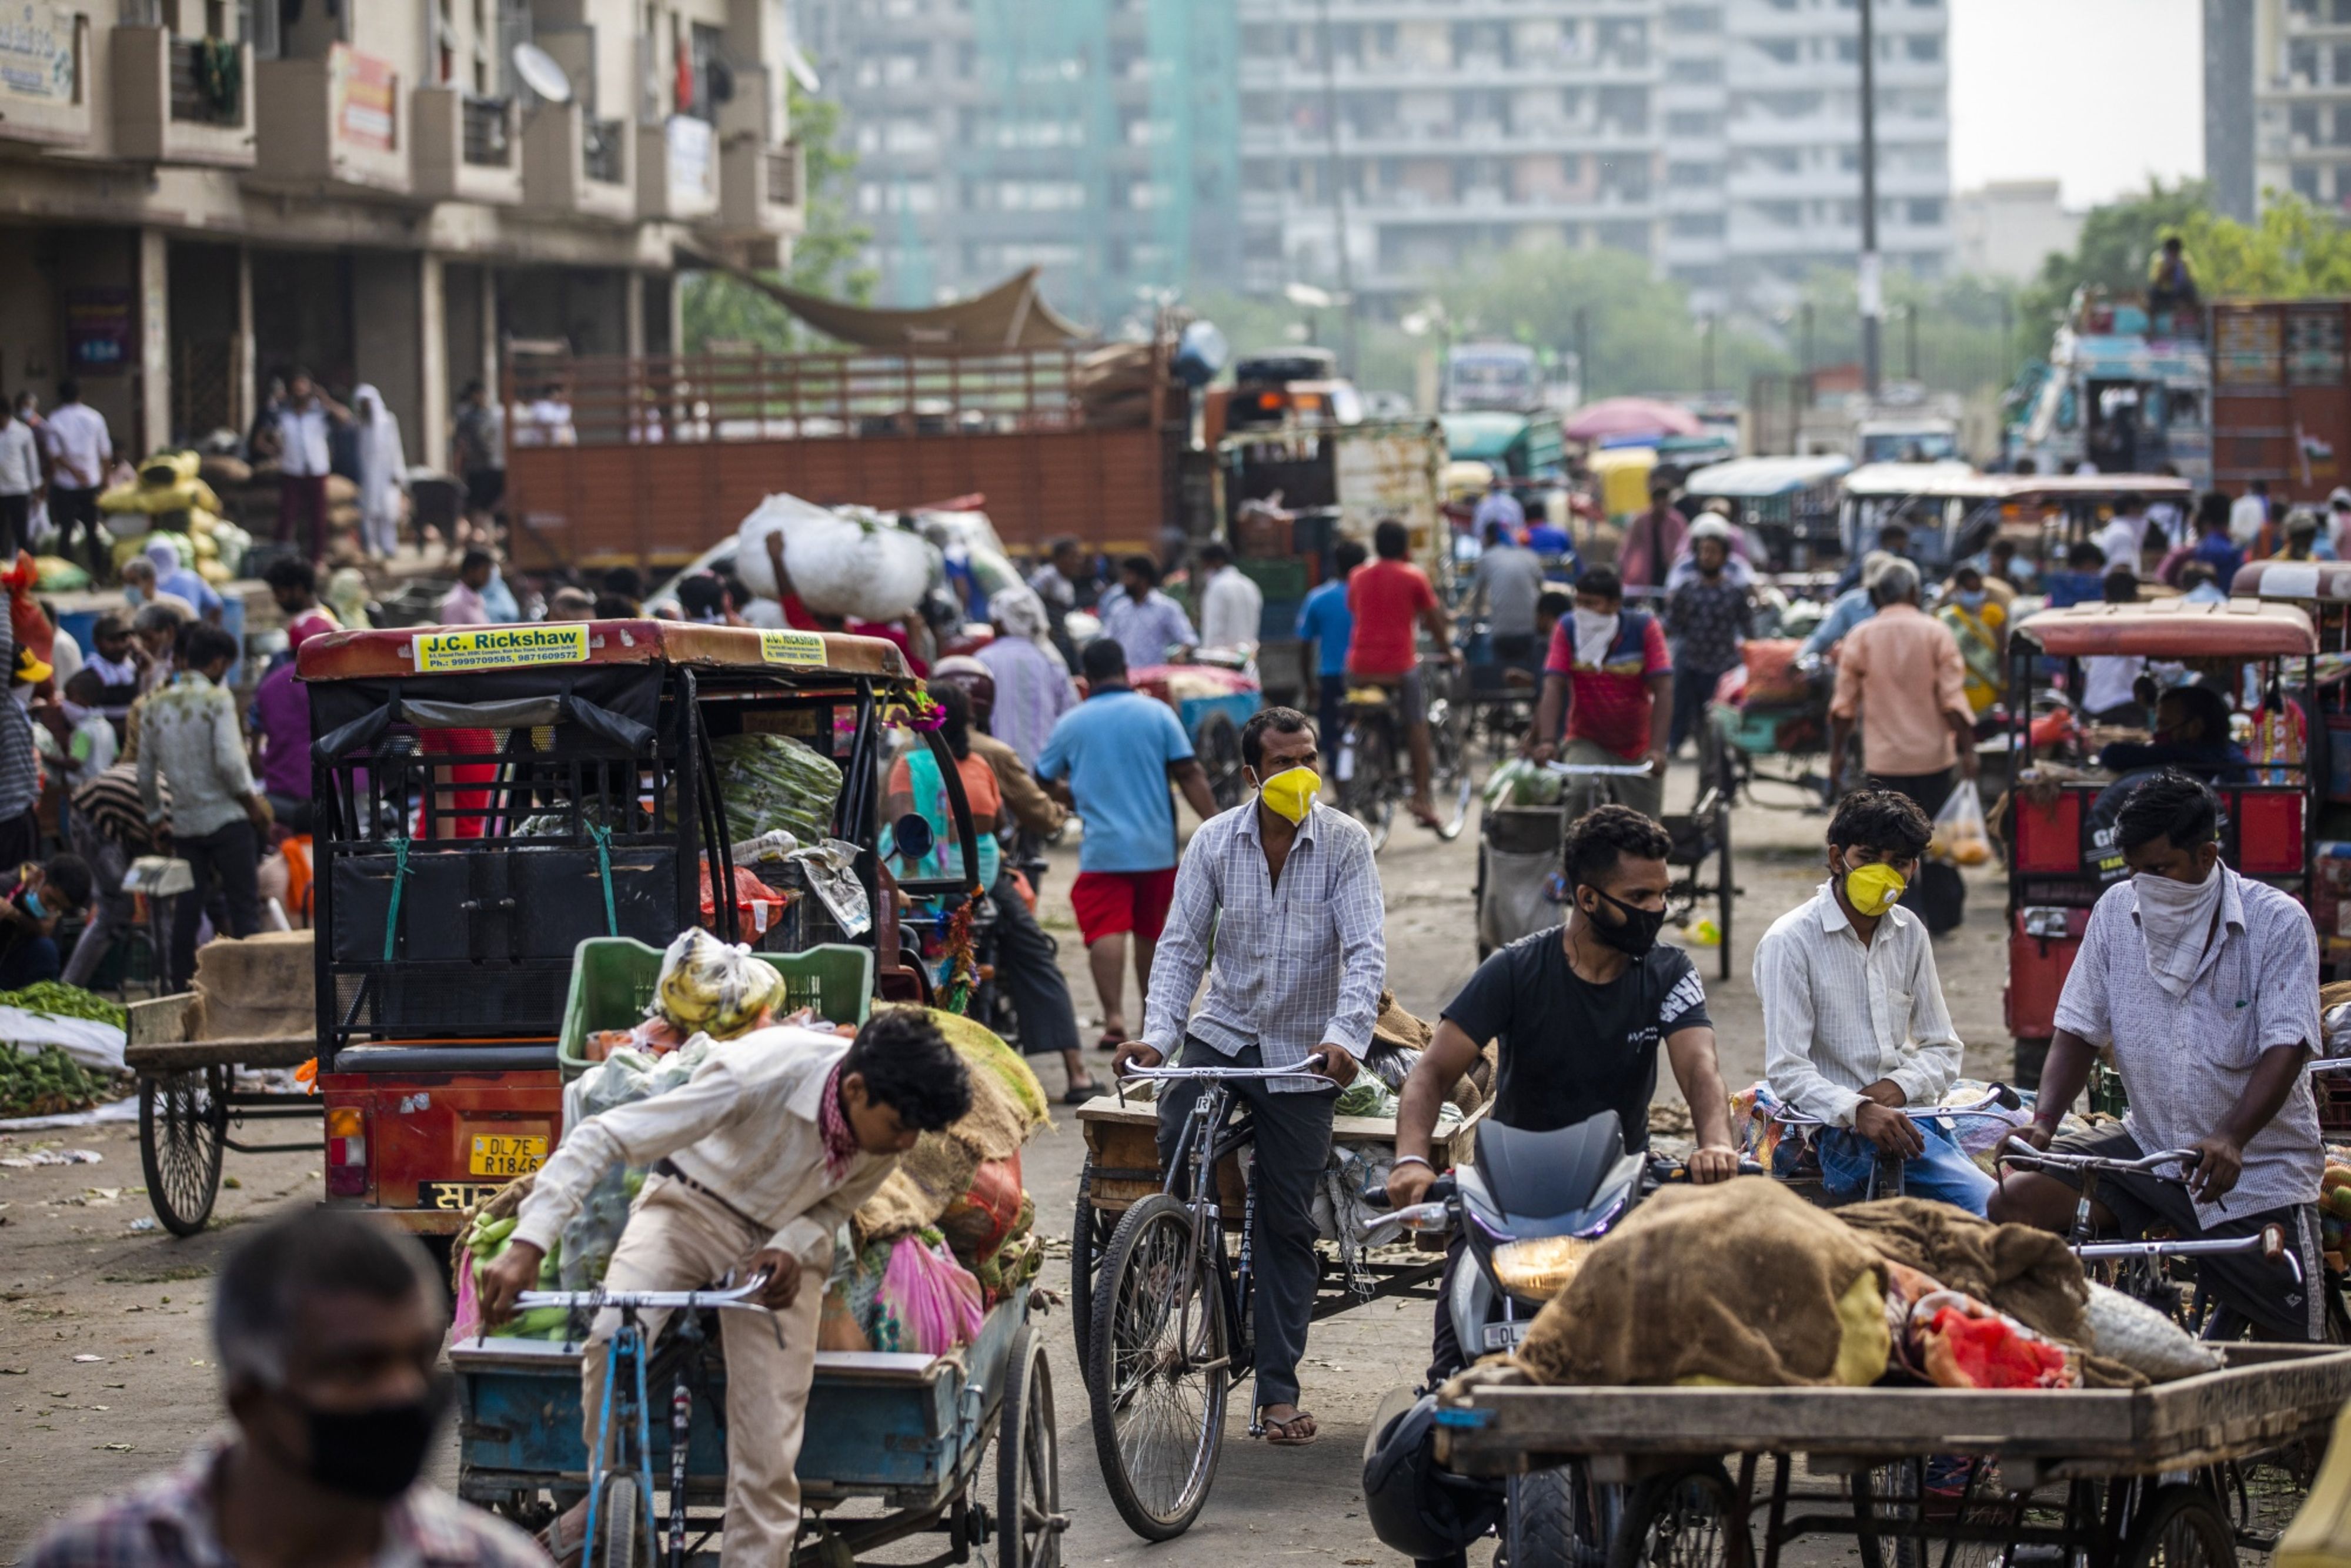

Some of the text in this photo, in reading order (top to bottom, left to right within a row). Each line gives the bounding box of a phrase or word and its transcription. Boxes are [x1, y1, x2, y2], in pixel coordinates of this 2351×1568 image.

[428, 631, 577, 652] J.C. Rickshaw
[490, 1138, 532, 1155] DL7E
[485, 1156, 538, 1174] R1846
[1240, 1199, 1255, 1261] NEELAM
[1500, 1326, 1520, 1344] DL
